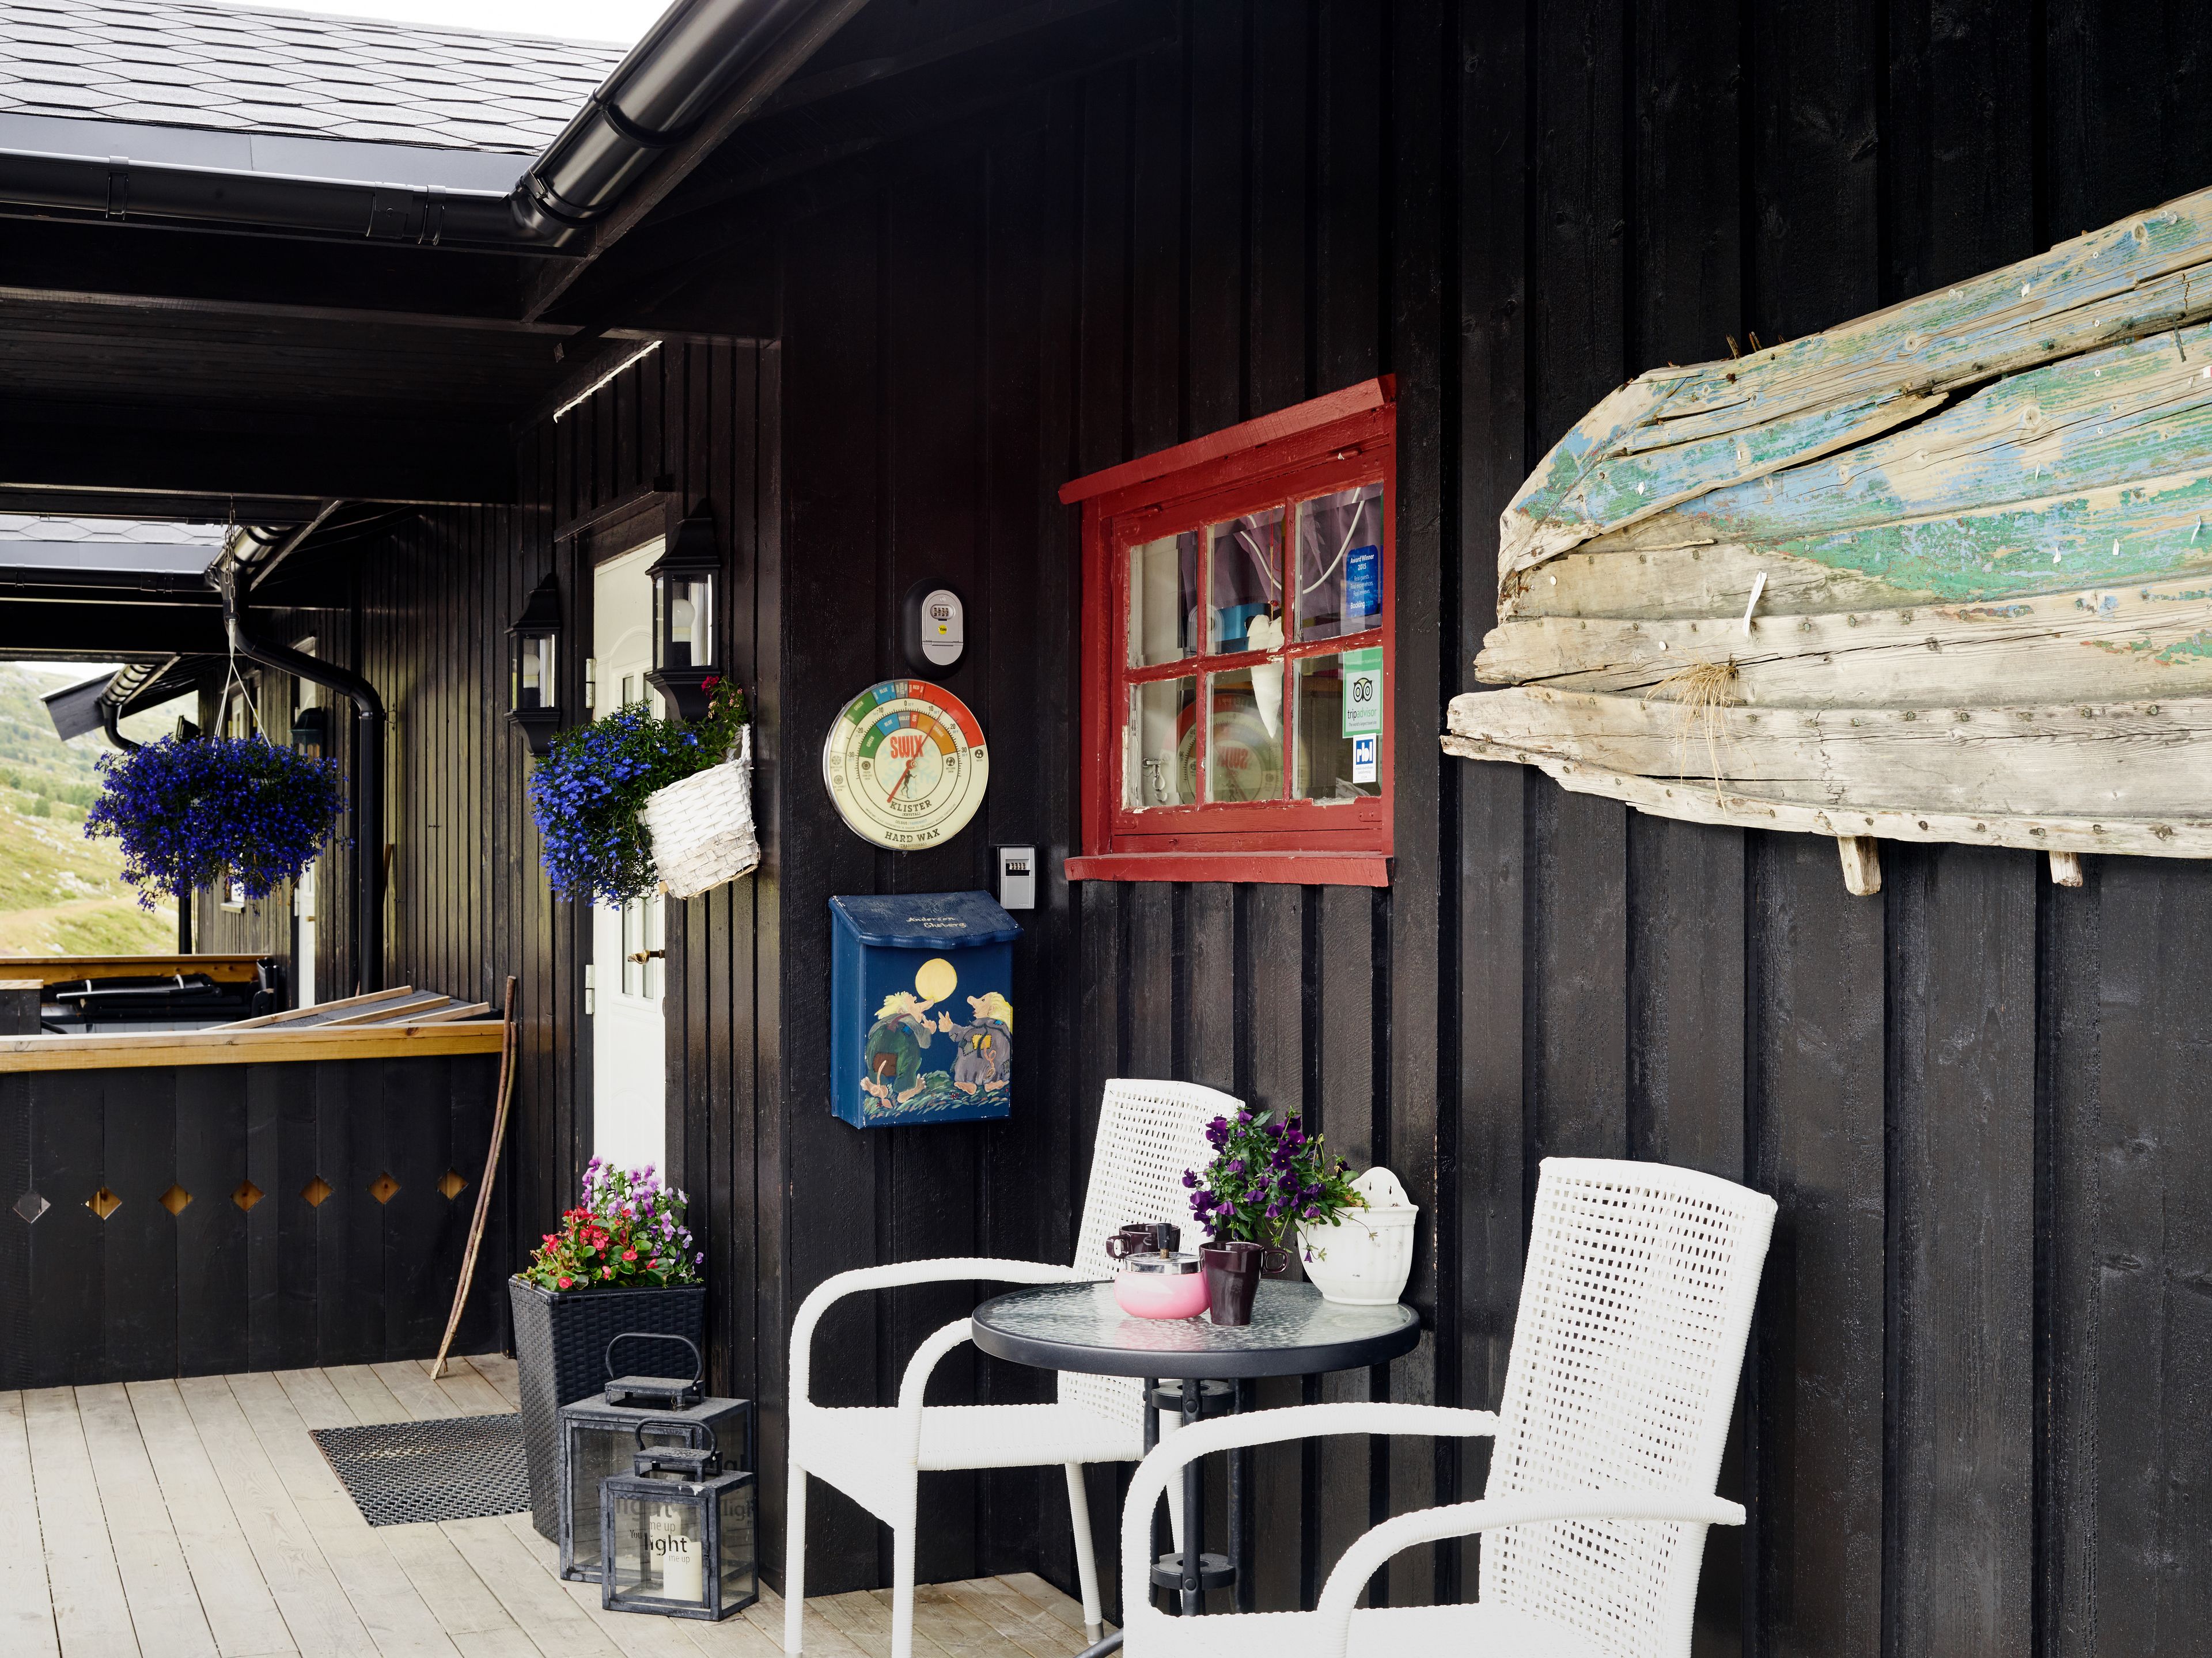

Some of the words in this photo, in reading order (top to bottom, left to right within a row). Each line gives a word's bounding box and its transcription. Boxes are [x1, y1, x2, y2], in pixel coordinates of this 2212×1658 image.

[1350, 556, 1361, 564] Award
[1350, 600, 1373, 609] Booking.com
[1347, 707, 1377, 721] tripadvisor
[866, 735, 874, 747] GREEN
[890, 735, 924, 759] SWIX
[1357, 741, 1372, 762] rbl
[890, 799, 932, 813] KLISTER
[885, 831, 913, 843] HARD
[916, 828, 940, 842] WAX
[630, 1530, 642, 1539] You
[664, 1523, 676, 1534] up
[644, 1532, 687, 1556] light
[681, 1555, 690, 1564] up
